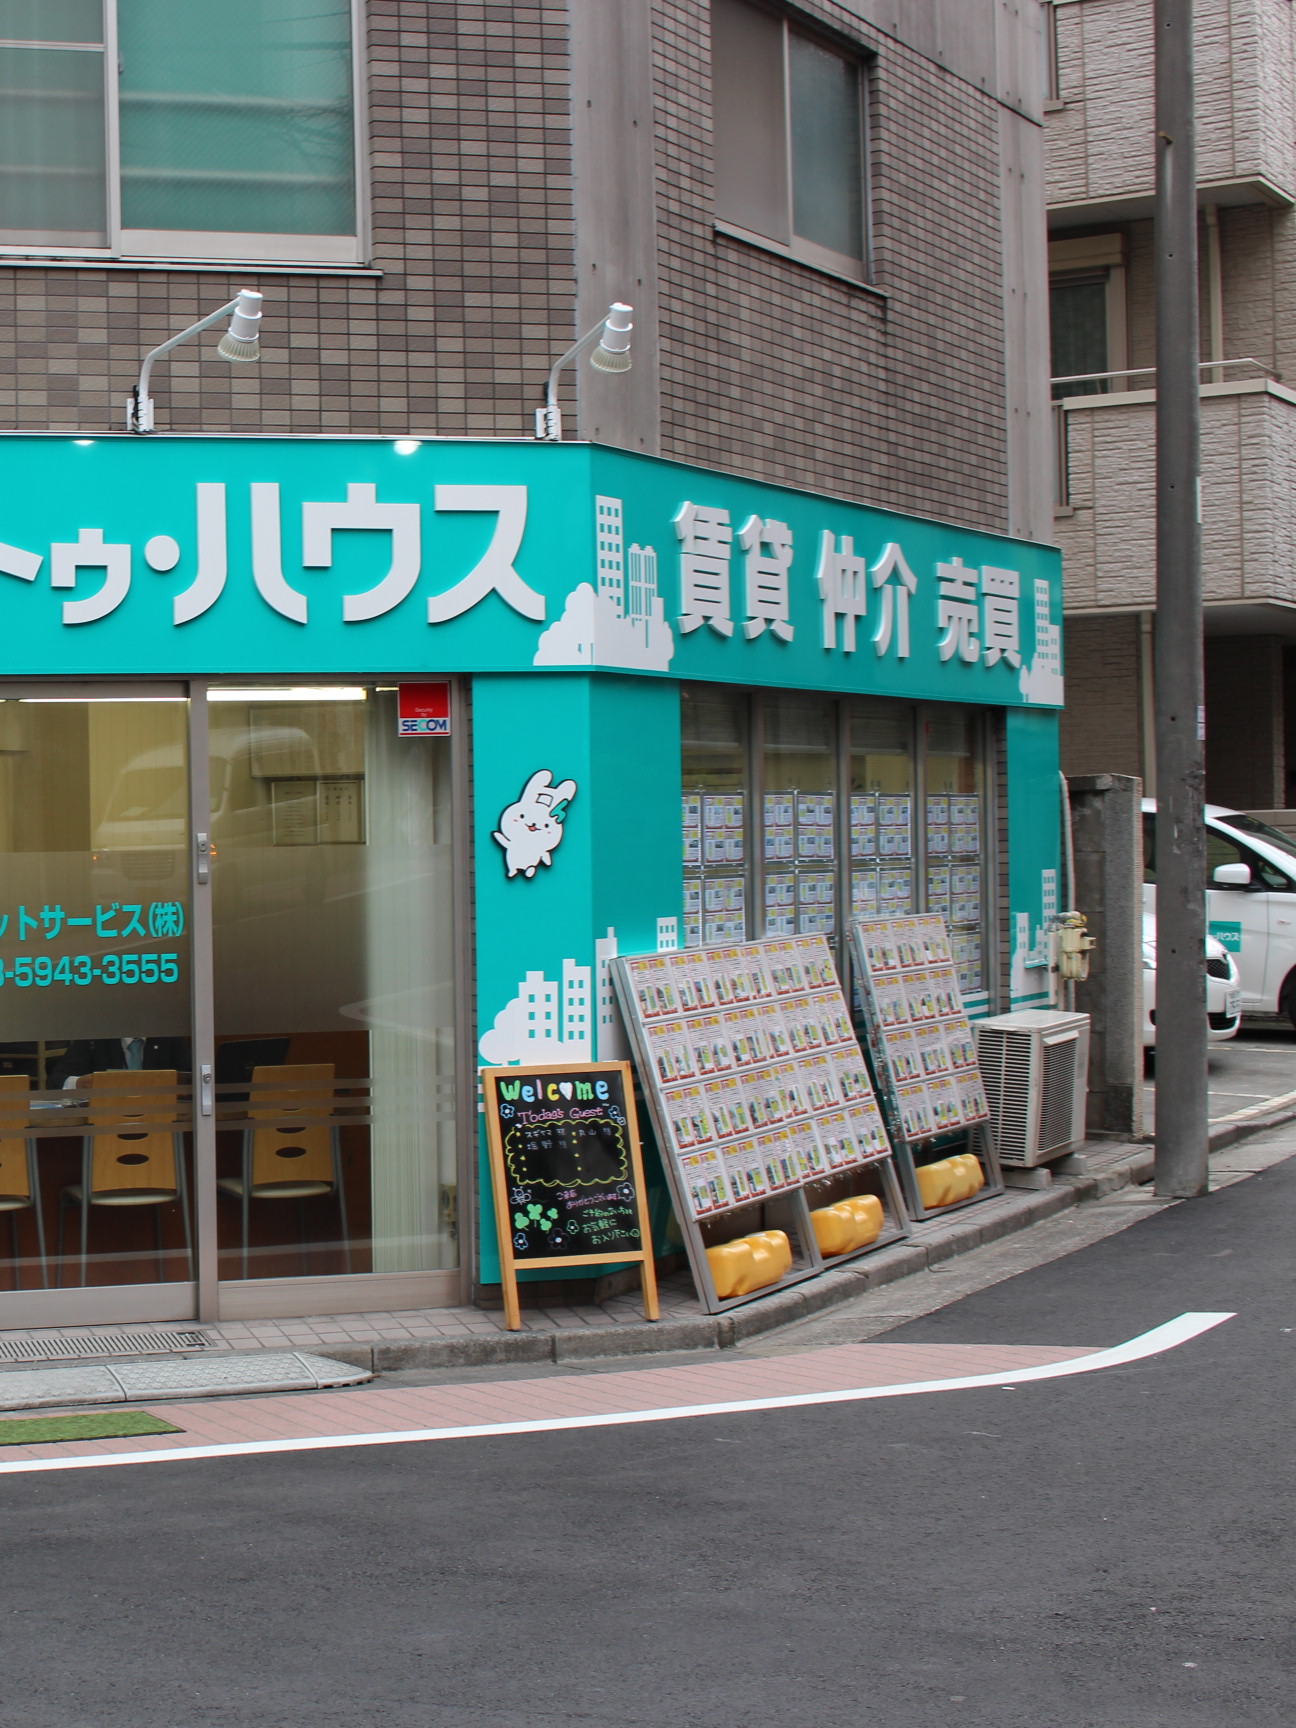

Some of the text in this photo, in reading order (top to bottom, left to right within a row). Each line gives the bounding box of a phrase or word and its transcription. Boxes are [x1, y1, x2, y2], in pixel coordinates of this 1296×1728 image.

[670, 500, 1022, 670] 賃貸 仲介 売買
[402, 719, 447, 732] SECOM
[569, 1106, 604, 1119] Guest
